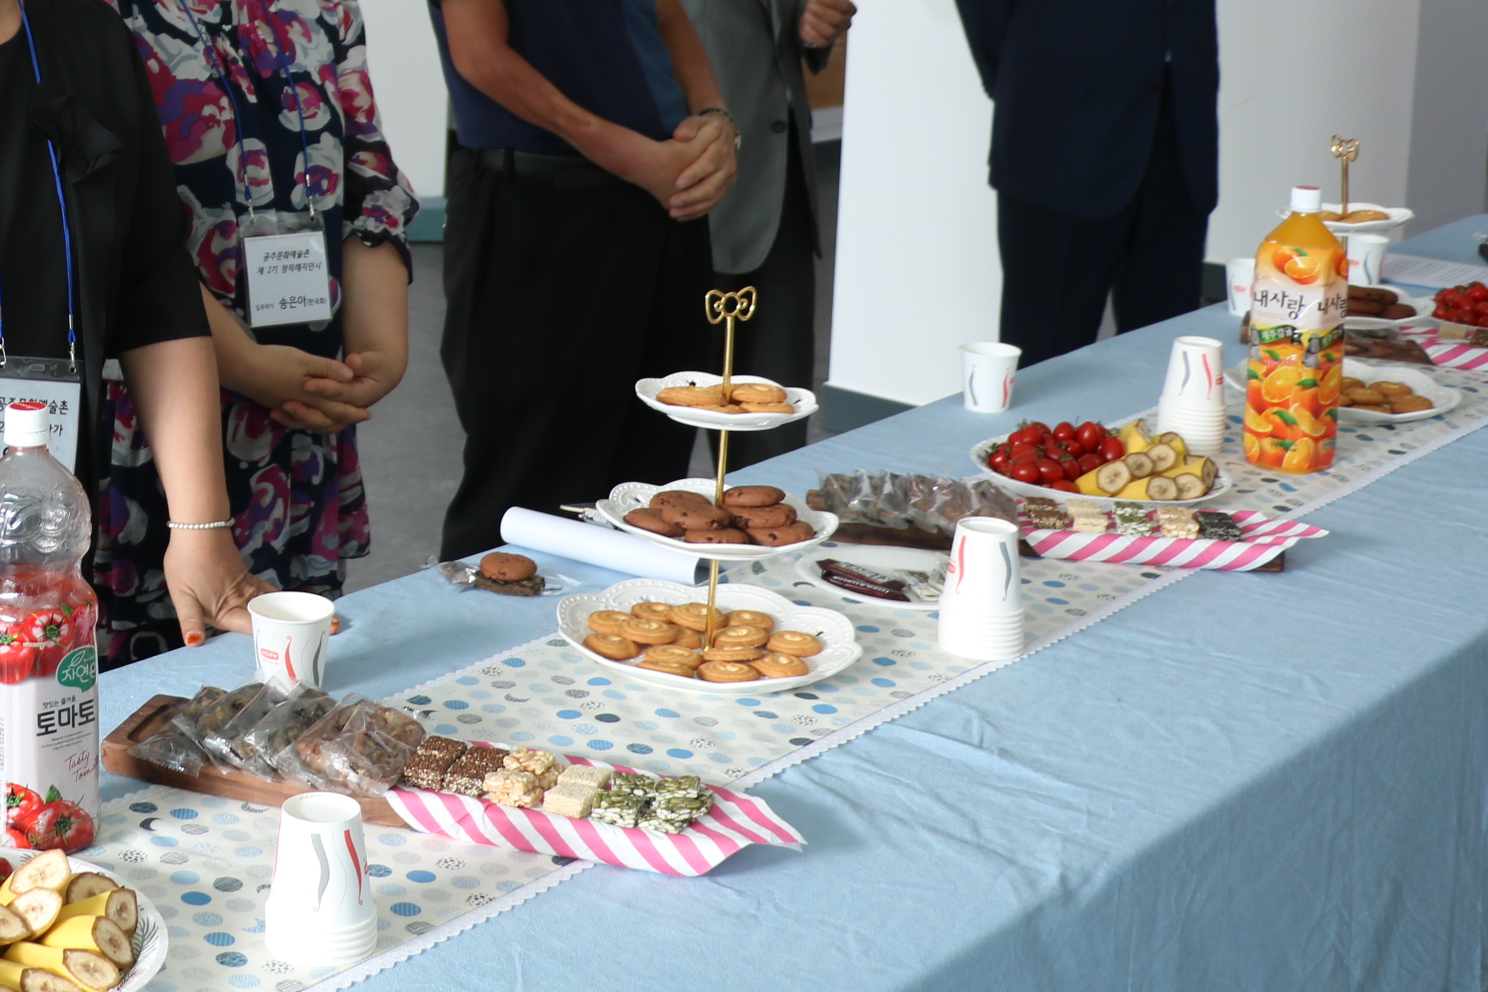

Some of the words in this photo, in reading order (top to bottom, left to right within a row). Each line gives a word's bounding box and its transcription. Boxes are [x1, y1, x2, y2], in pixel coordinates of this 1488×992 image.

[257, 267, 264, 275] 제
[267, 266, 278, 274] 2기
[1253, 289, 1305, 320] 내사랑
[43, 700, 59, 710] 맛있는
[36, 699, 95, 736] 토마토
[64, 749, 90, 771] Tasty
